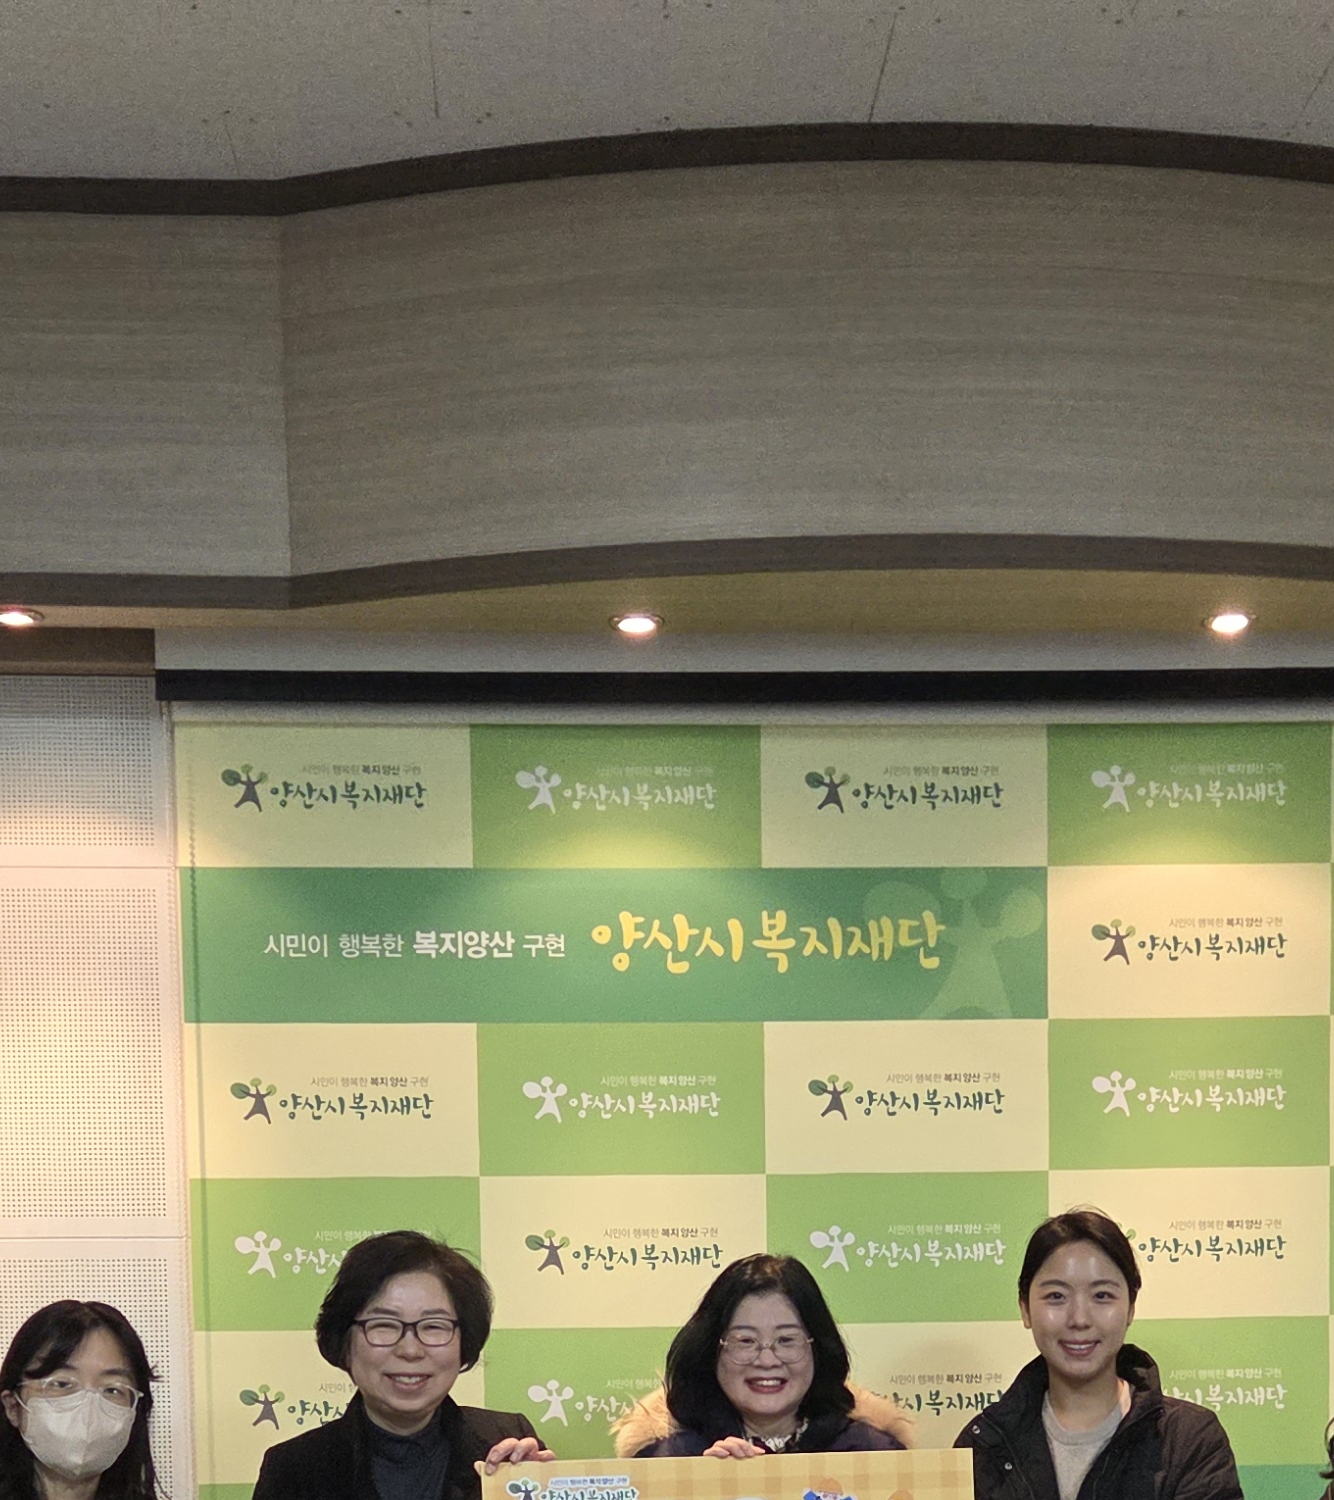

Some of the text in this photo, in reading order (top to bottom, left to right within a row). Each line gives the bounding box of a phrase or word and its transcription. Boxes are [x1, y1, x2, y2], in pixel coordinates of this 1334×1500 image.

[264, 933, 328, 958] 시민이
[339, 933, 403, 958] 행복한
[413, 930, 515, 959] 복지양산
[523, 934, 565, 958] 구현
